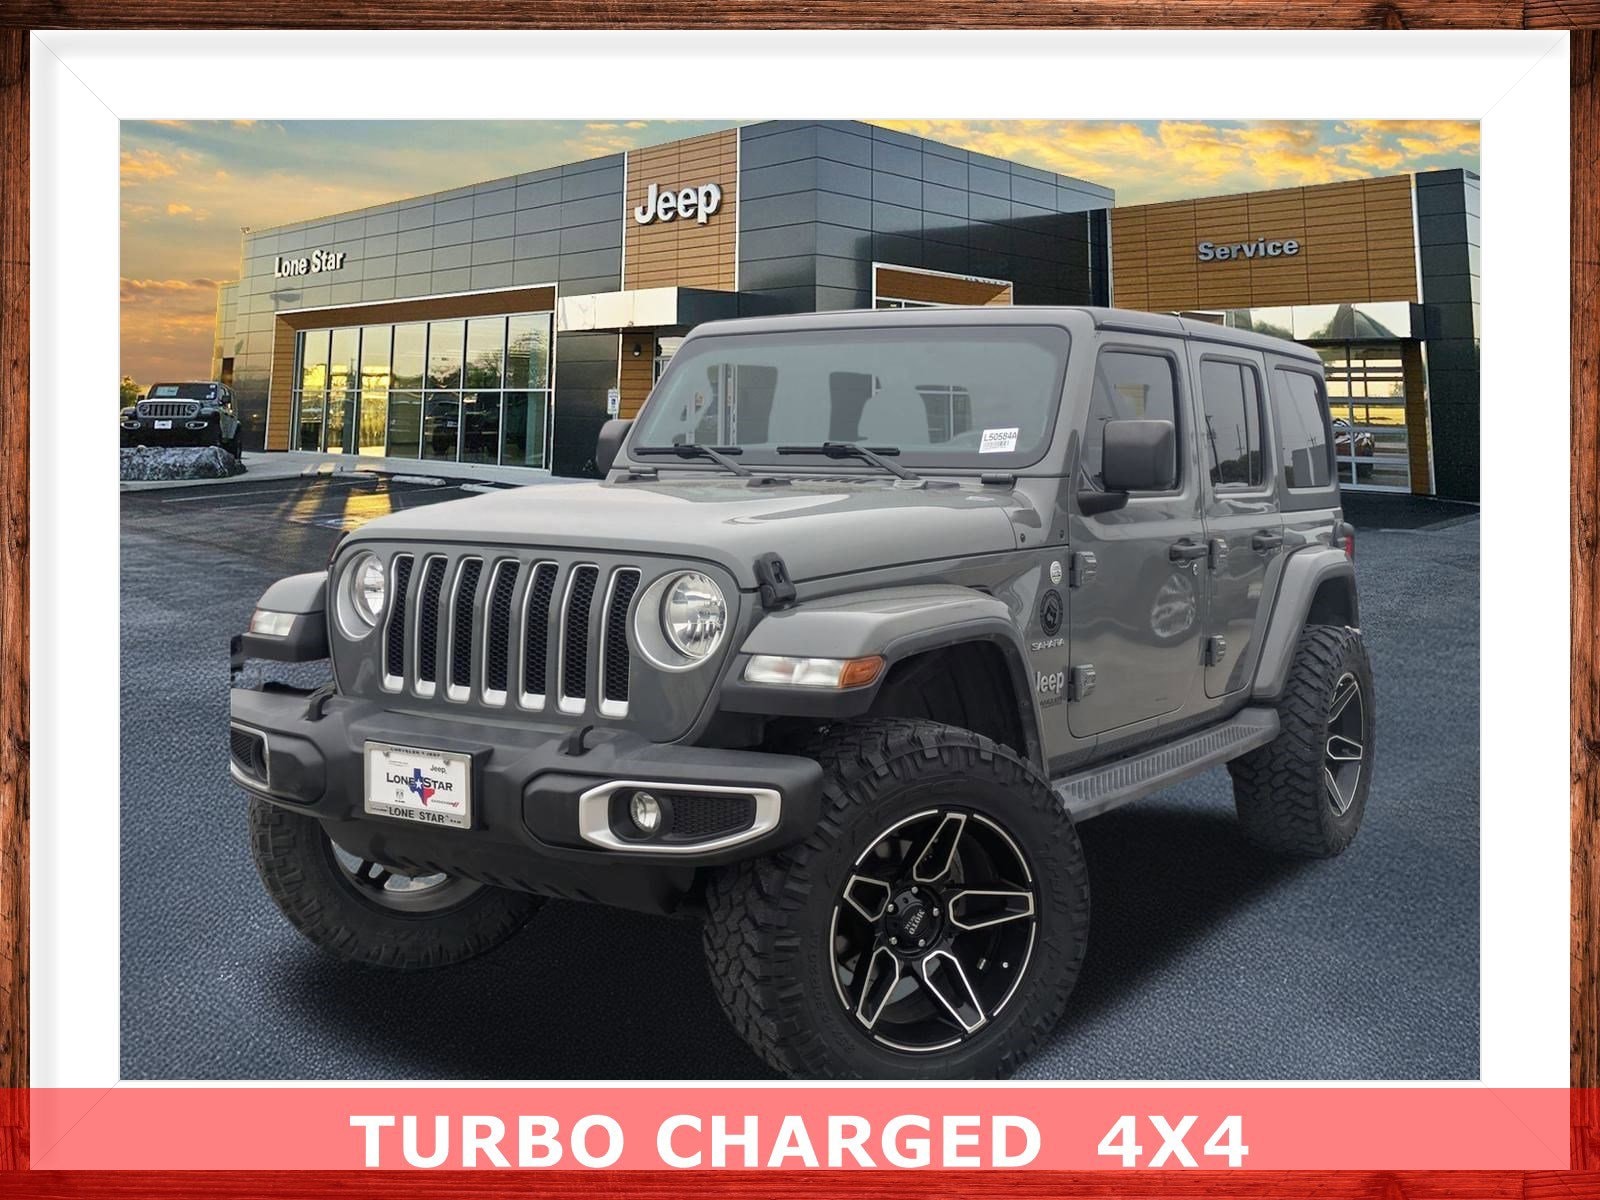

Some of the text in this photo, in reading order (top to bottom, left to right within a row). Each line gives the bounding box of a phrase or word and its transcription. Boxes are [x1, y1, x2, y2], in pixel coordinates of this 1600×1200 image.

[634, 183, 722, 225] Jeep
[1198, 237, 1299, 261] Service
[275, 249, 346, 277] Lone Star
[430, 764, 446, 774] Jeep
[386, 772, 453, 791] LONE STAR
[389, 806, 415, 818] LONE
[419, 811, 445, 824] STAR
